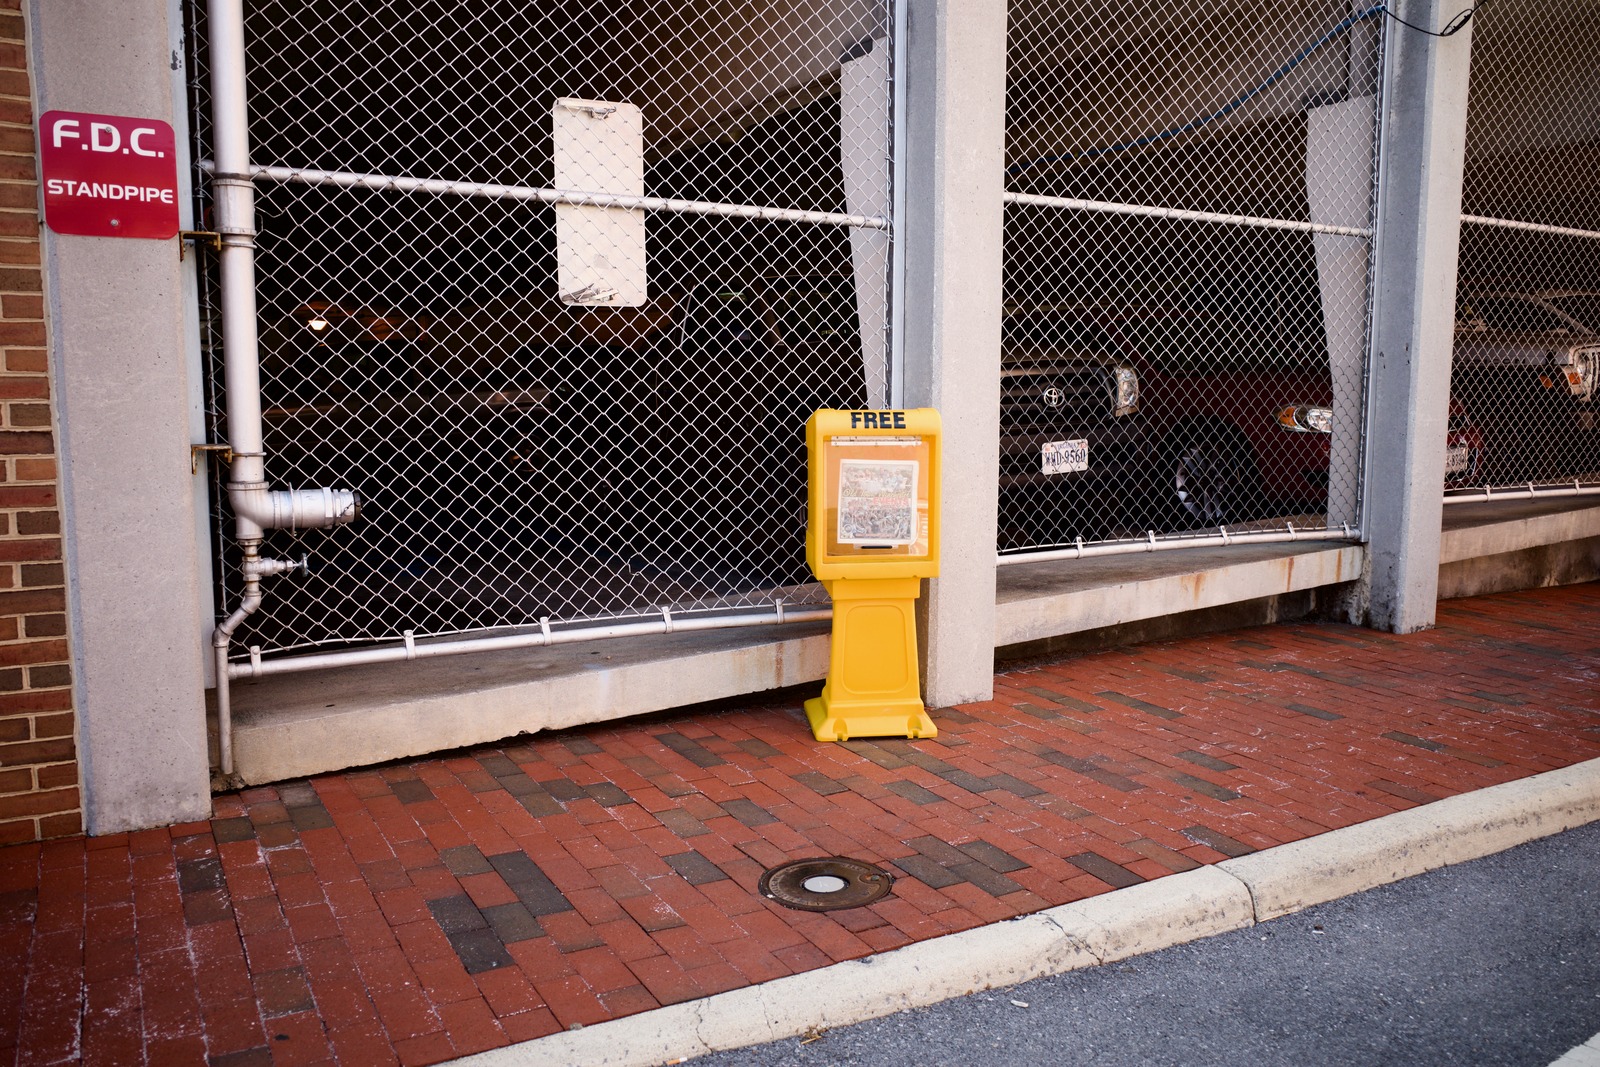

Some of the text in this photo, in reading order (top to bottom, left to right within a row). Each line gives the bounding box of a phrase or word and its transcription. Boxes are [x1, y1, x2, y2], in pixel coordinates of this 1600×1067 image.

[52, 119, 165, 158] F.D.C.
[47, 178, 174, 204] STANDPIPE
[850, 411, 907, 429] FREE
